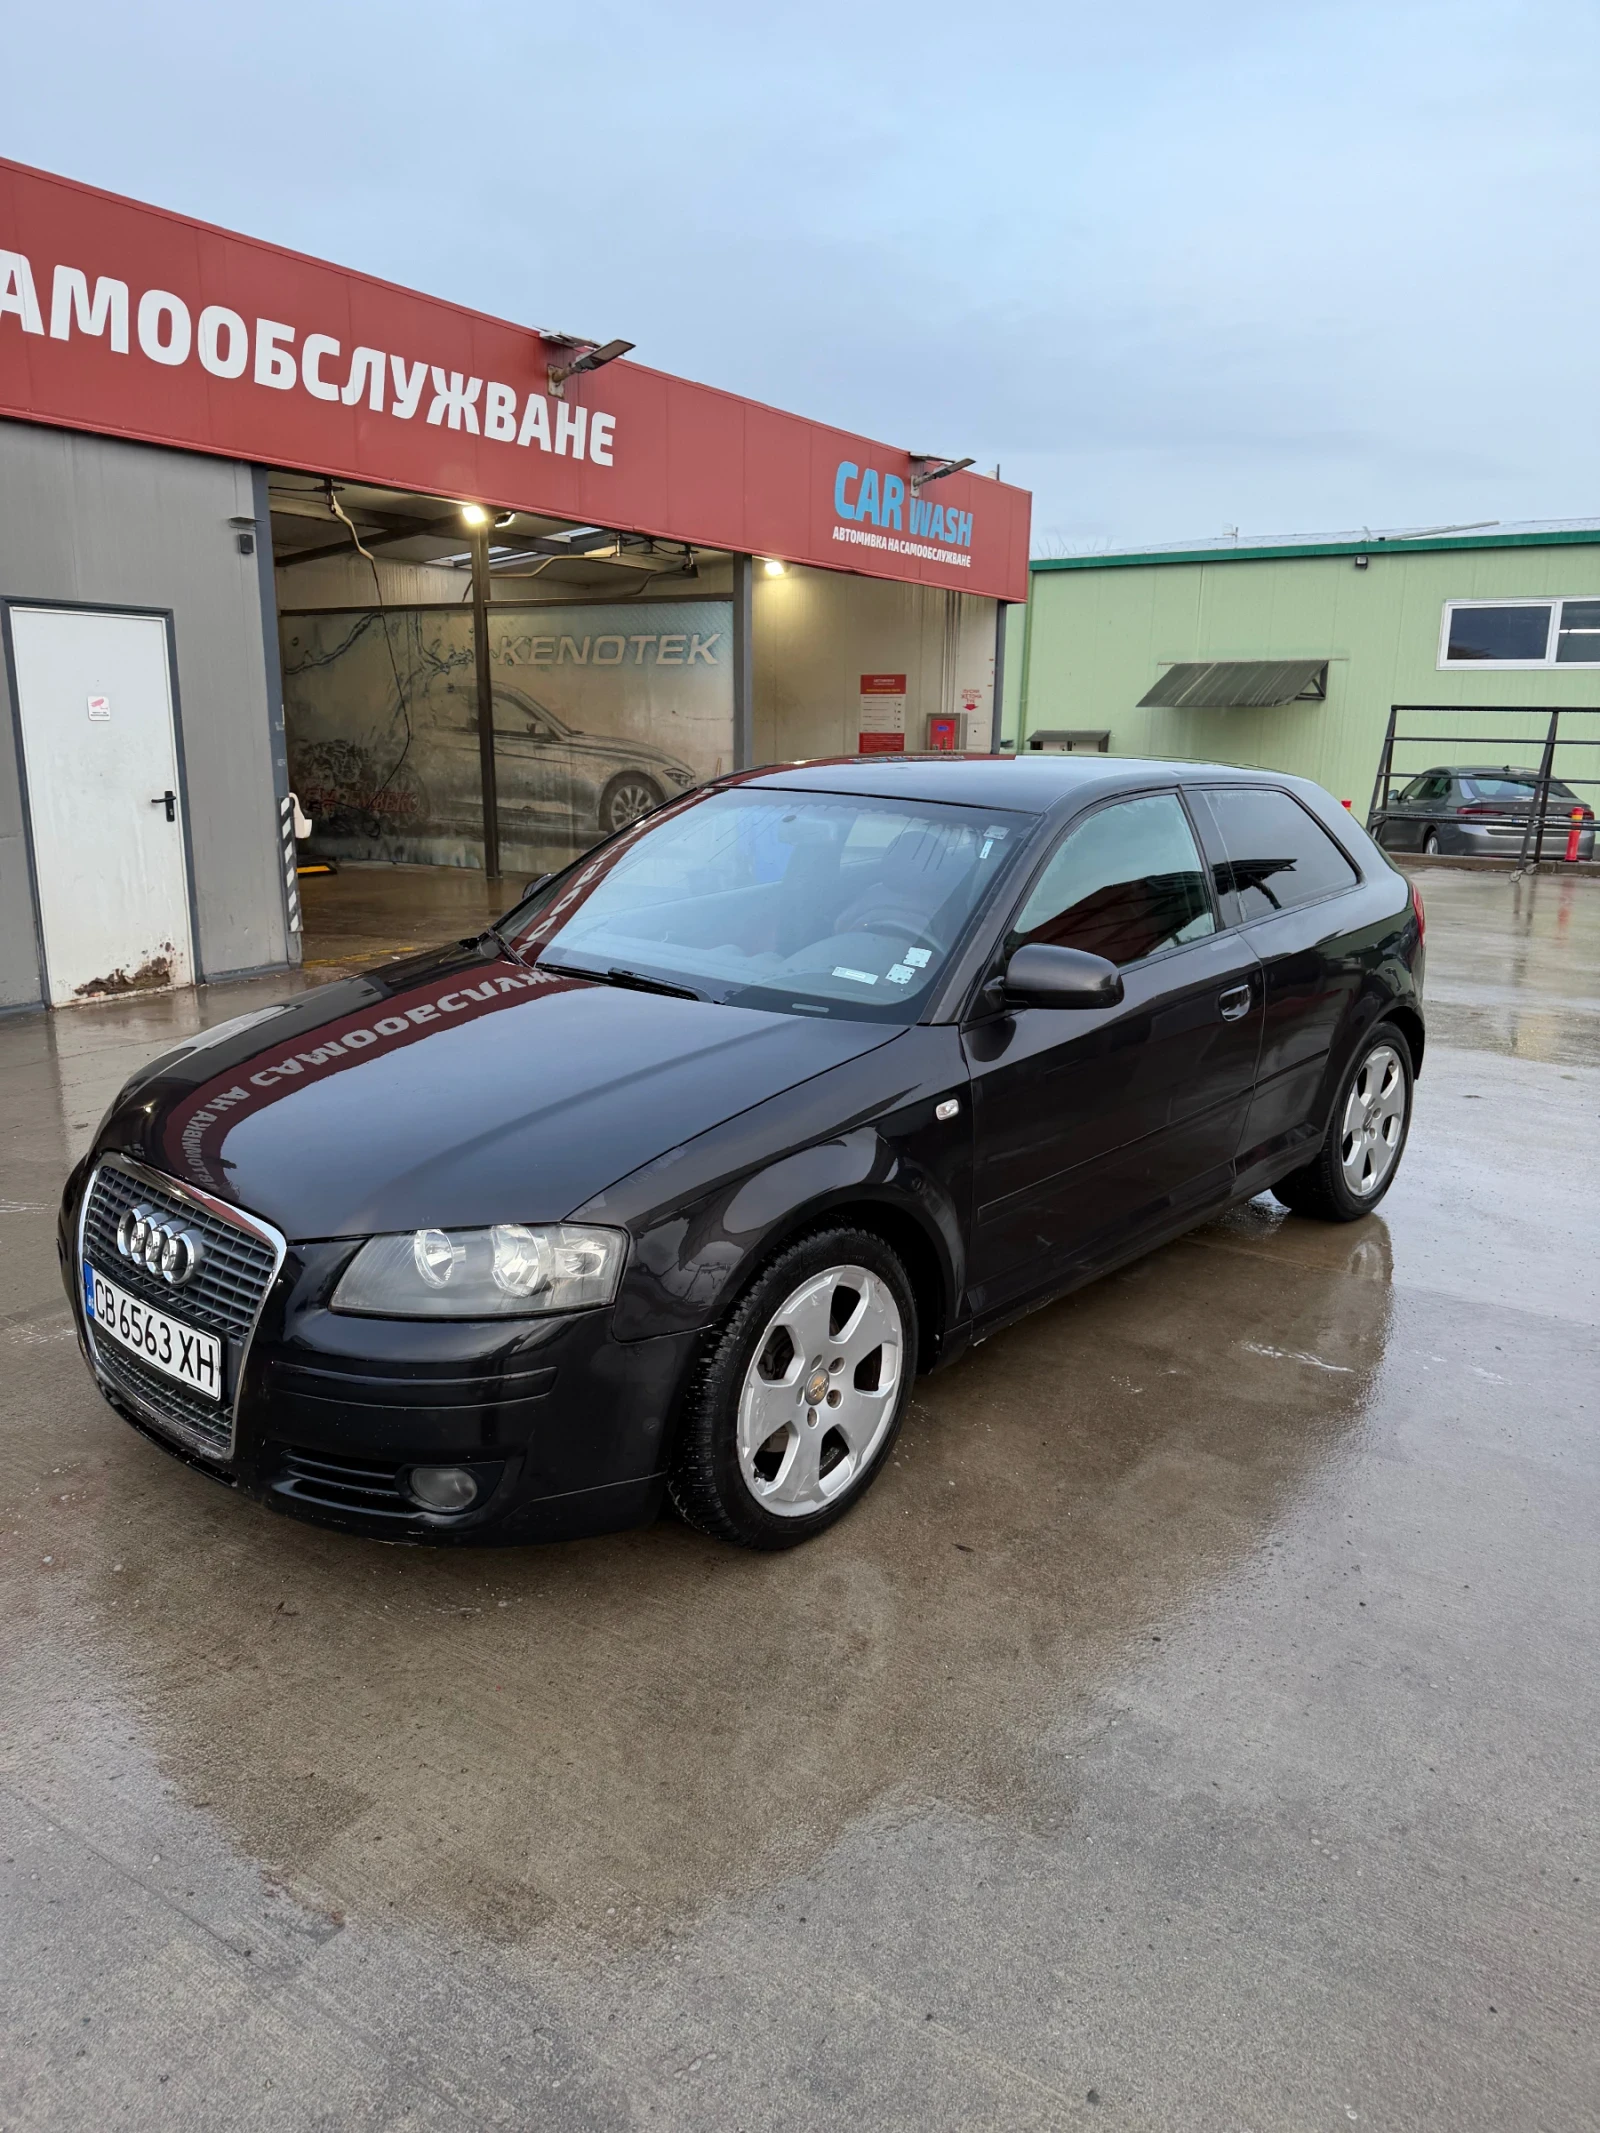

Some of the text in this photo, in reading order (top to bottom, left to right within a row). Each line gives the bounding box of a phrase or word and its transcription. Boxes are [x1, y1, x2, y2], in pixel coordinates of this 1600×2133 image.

[834, 461, 973, 547] CAR WASH
[832, 526, 971, 567] АВТОМИВКА НА САМООБСЛУЖВАНЕ
[499, 633, 723, 666] KENOTEK
[95, 1278, 214, 1388] CB 6563 XH
